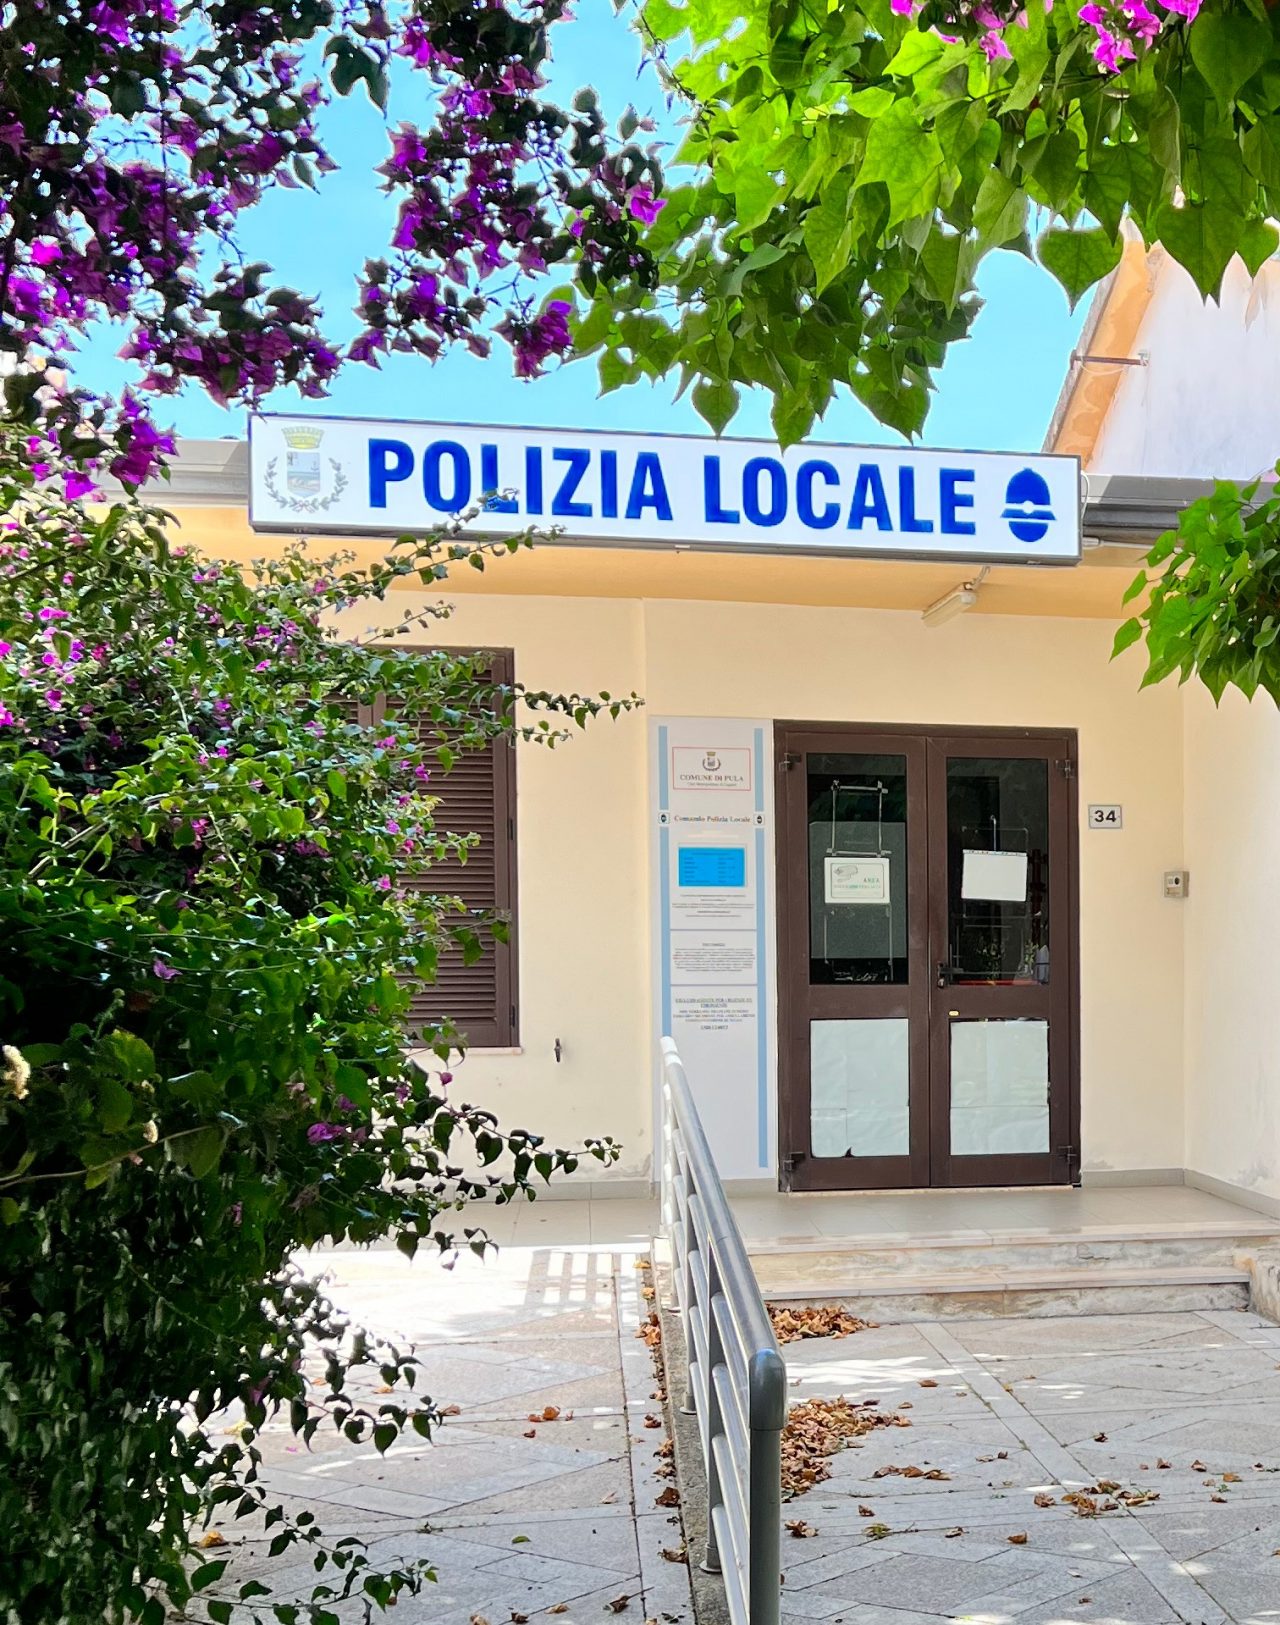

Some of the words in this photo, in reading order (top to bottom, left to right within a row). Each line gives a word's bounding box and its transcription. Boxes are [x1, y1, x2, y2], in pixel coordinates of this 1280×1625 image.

[368, 437, 674, 521] POLIZIA
[703, 455, 976, 535] LOCALE
[679, 774, 713, 782] COMUNE
[1094, 809, 1117, 823] 34
